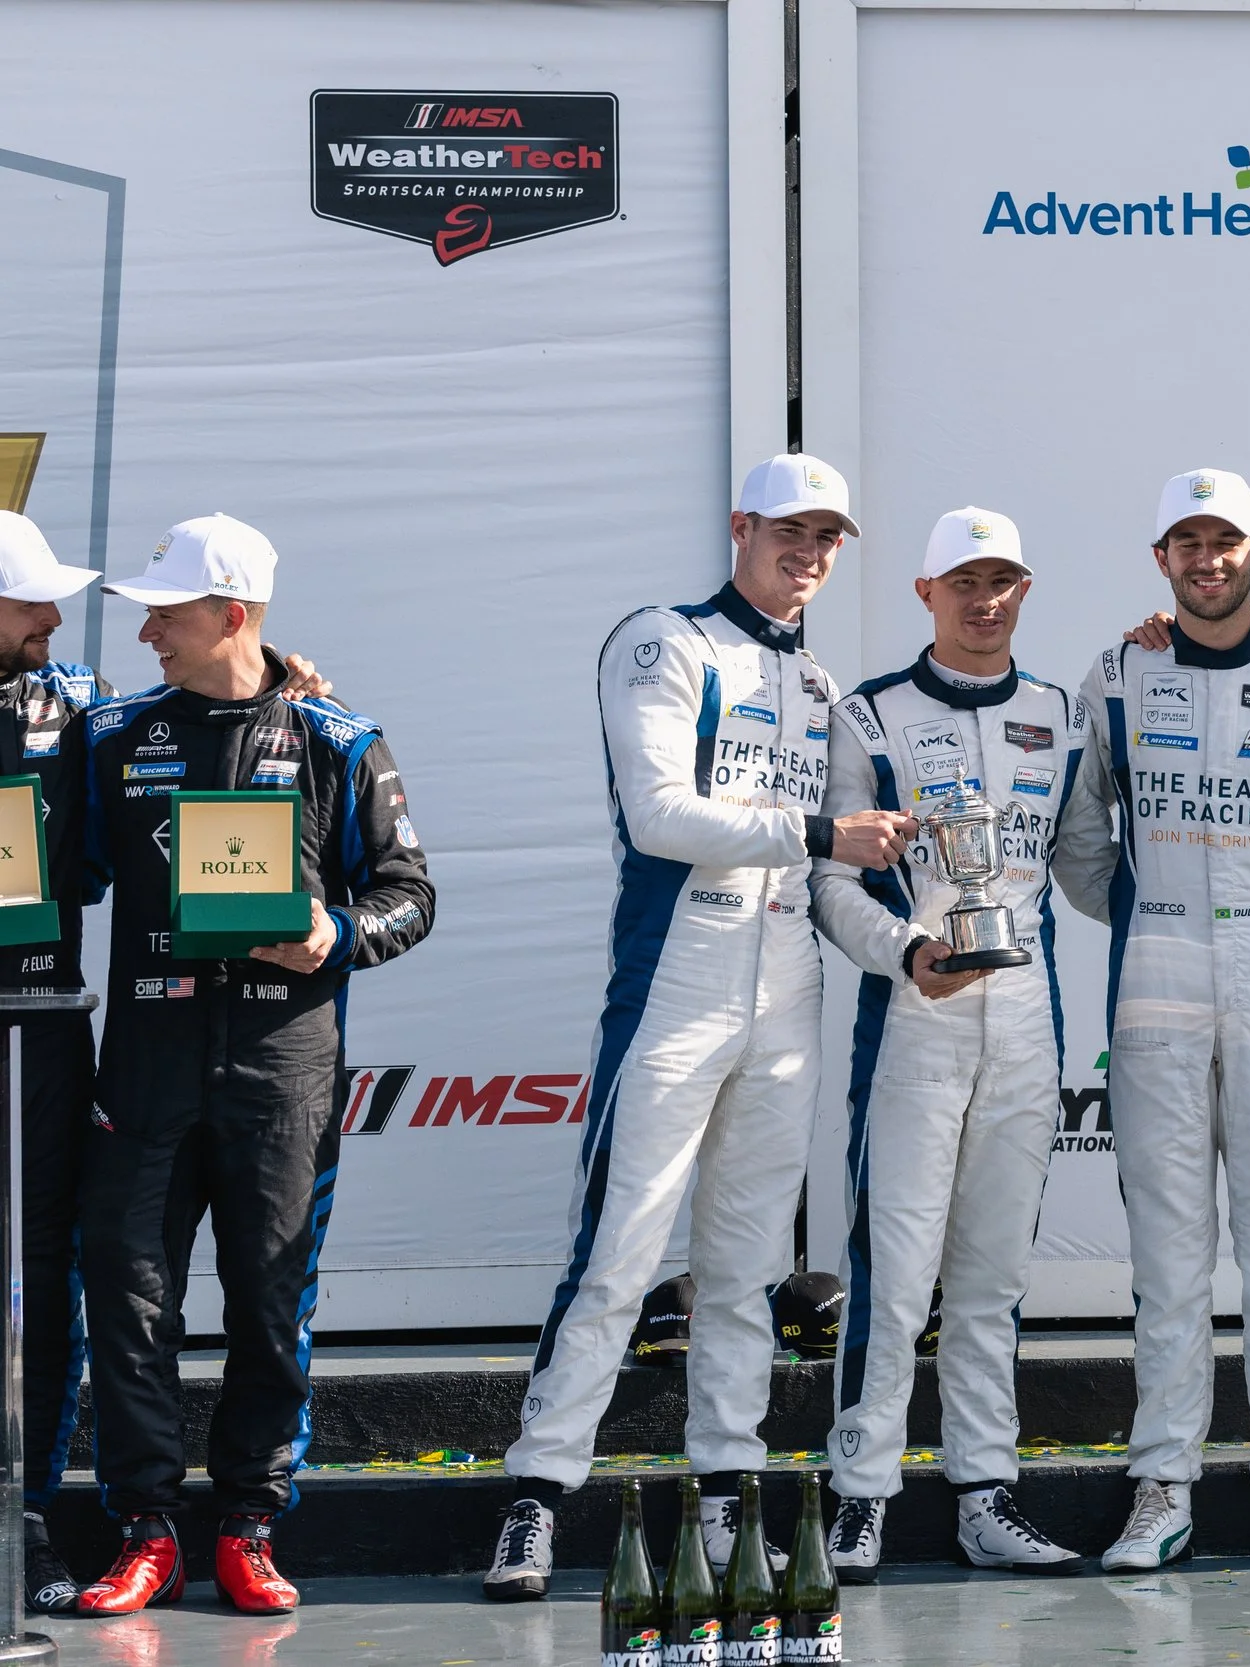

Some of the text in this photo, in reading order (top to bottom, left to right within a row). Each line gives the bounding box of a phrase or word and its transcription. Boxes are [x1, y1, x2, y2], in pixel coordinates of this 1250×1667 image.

[441, 107, 524, 128] IMSA
[328, 143, 605, 169] WeatherTech
[214, 582, 239, 592] ROLEX
[1146, 688, 1188, 702] AMR
[92, 712, 123, 731] OMP
[741, 709, 772, 721] MICHELIN
[845, 701, 880, 741] sparco
[322, 722, 355, 742] OMP
[915, 732, 959, 750] AMR
[1150, 737, 1193, 747] MICHELIN
[140, 766, 179, 775] MICHELIN
[1135, 771, 1185, 794] THE
[1137, 797, 1168, 819] OF
[1001, 811, 1052, 837] EART
[1148, 829, 1181, 844] JOIN
[1187, 832, 1215, 847] THE
[200, 861, 268, 875] ROLEX
[1003, 868, 1037, 882] DRIVE
[690, 890, 743, 906] sparco
[1139, 901, 1185, 915] sparco
[391, 908, 420, 931] RACING
[22, 954, 54, 973] P. ELLIS
[135, 981, 163, 996] OMP
[243, 983, 288, 1000] R. WARD
[782, 1325, 801, 1338] RD
